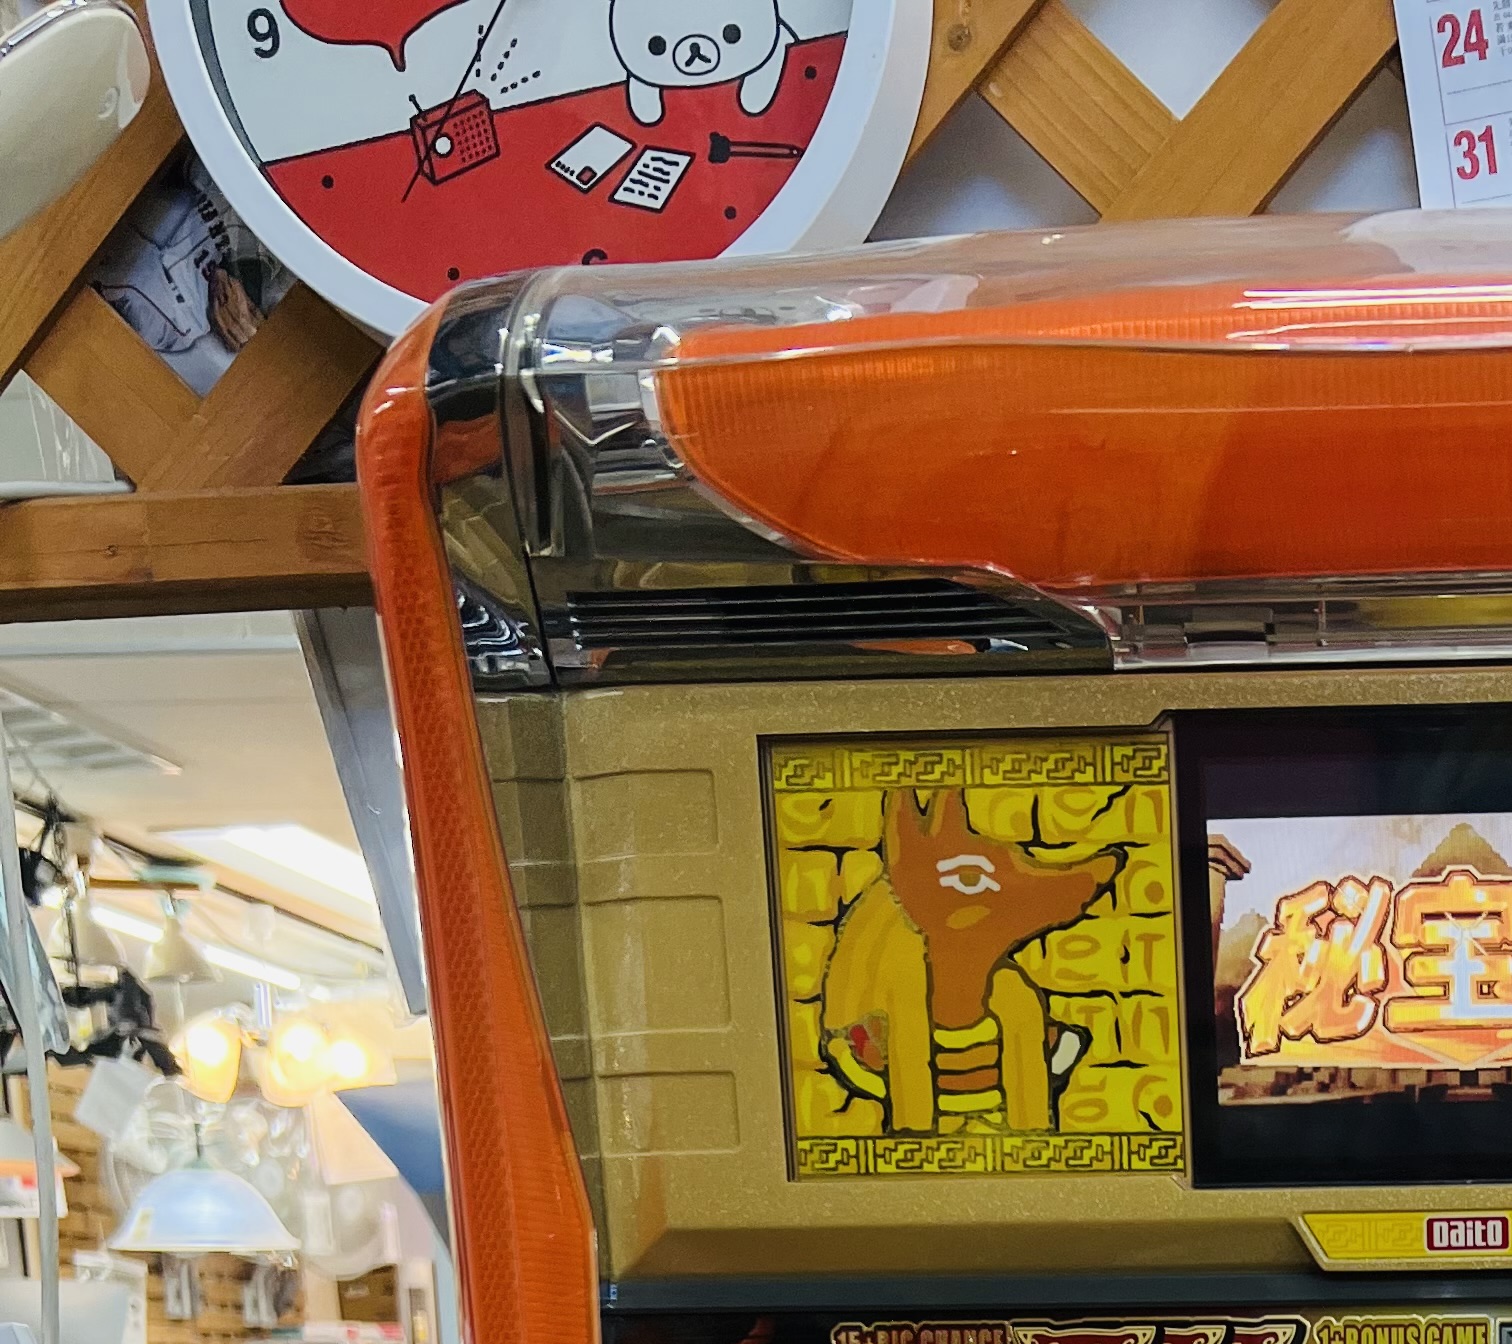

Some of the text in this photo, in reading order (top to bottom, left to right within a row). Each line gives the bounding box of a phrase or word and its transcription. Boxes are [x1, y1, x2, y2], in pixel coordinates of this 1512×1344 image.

[247, 9, 280, 58] 9
[1436, 8, 1491, 68] 24
[1455, 125, 1499, 181] 31
